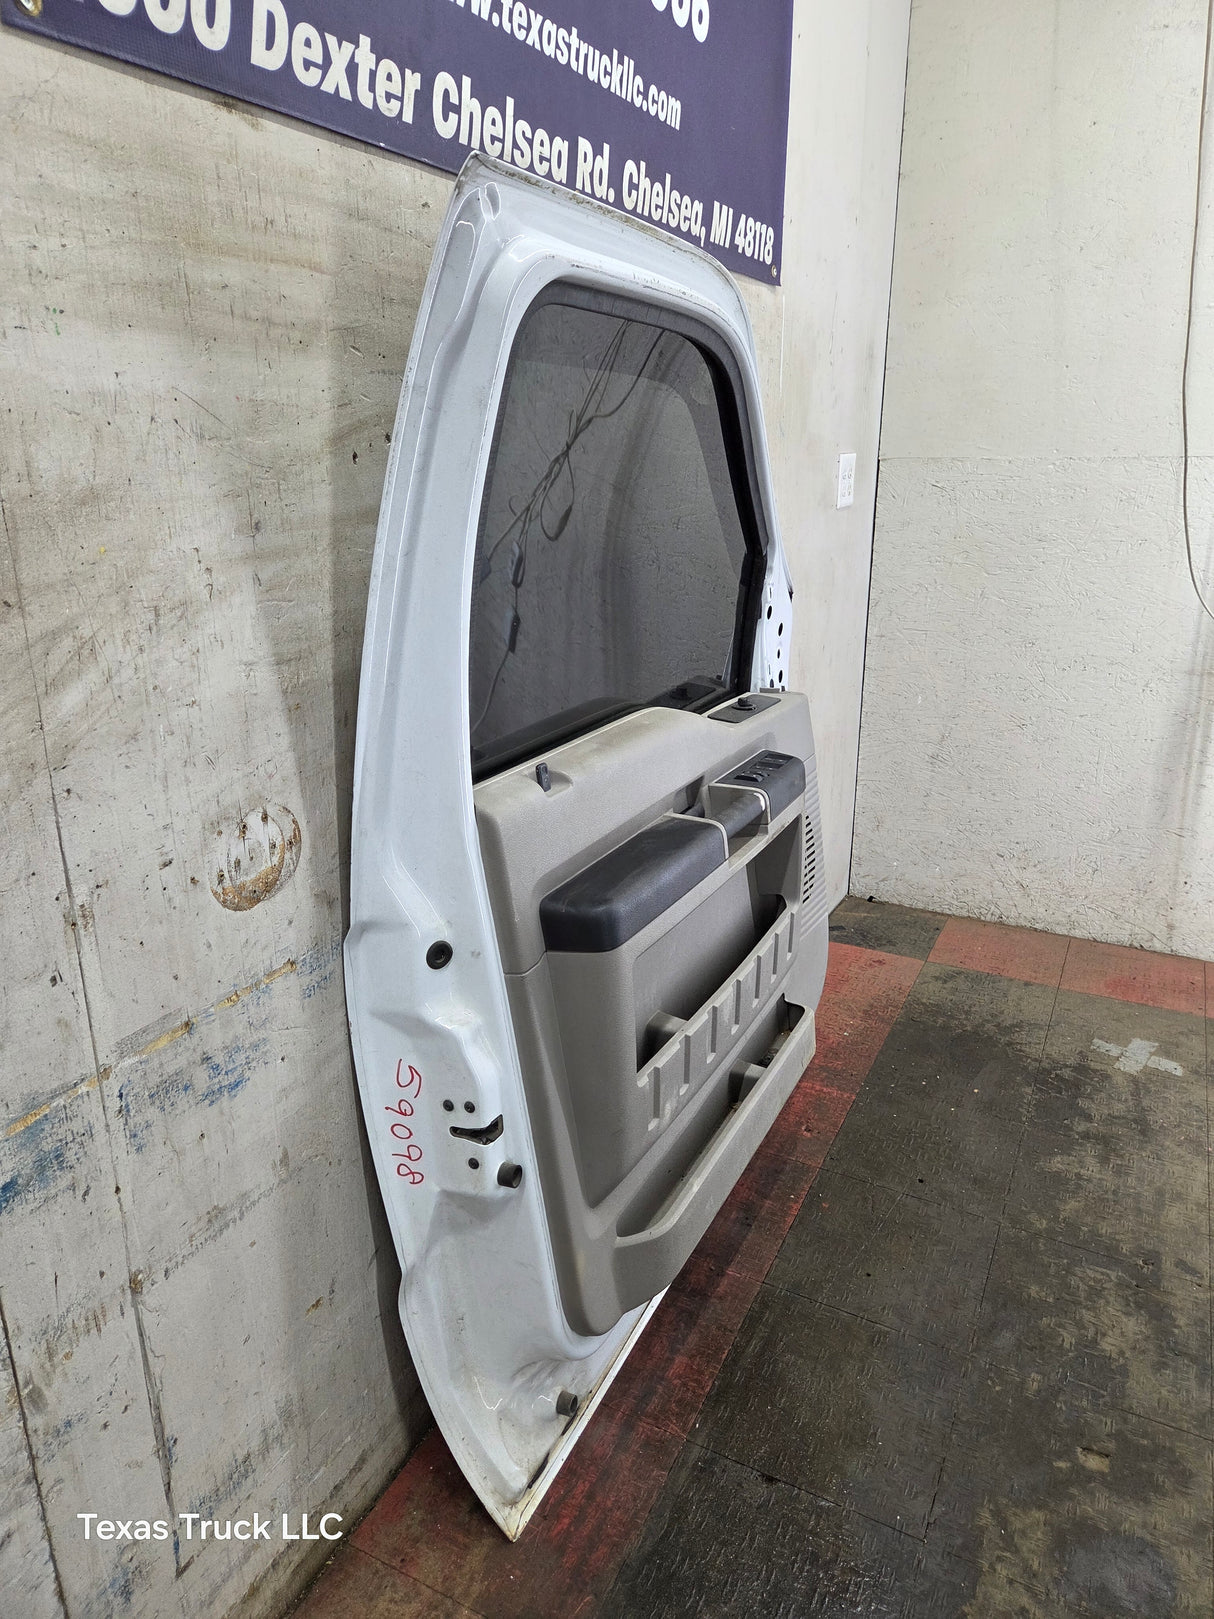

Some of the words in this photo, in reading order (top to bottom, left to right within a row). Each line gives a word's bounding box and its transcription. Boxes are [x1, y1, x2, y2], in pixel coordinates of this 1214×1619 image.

[449, 0, 682, 131] .texastruckllc.com
[251, 0, 421, 125] Dexter
[432, 71, 569, 184] Chelsea
[575, 136, 615, 203] Rd.
[622, 159, 706, 247] Chelsea,
[710, 201, 734, 249] MI
[734, 213, 775, 265] 48118
[385, 1058, 425, 1186] 59098
